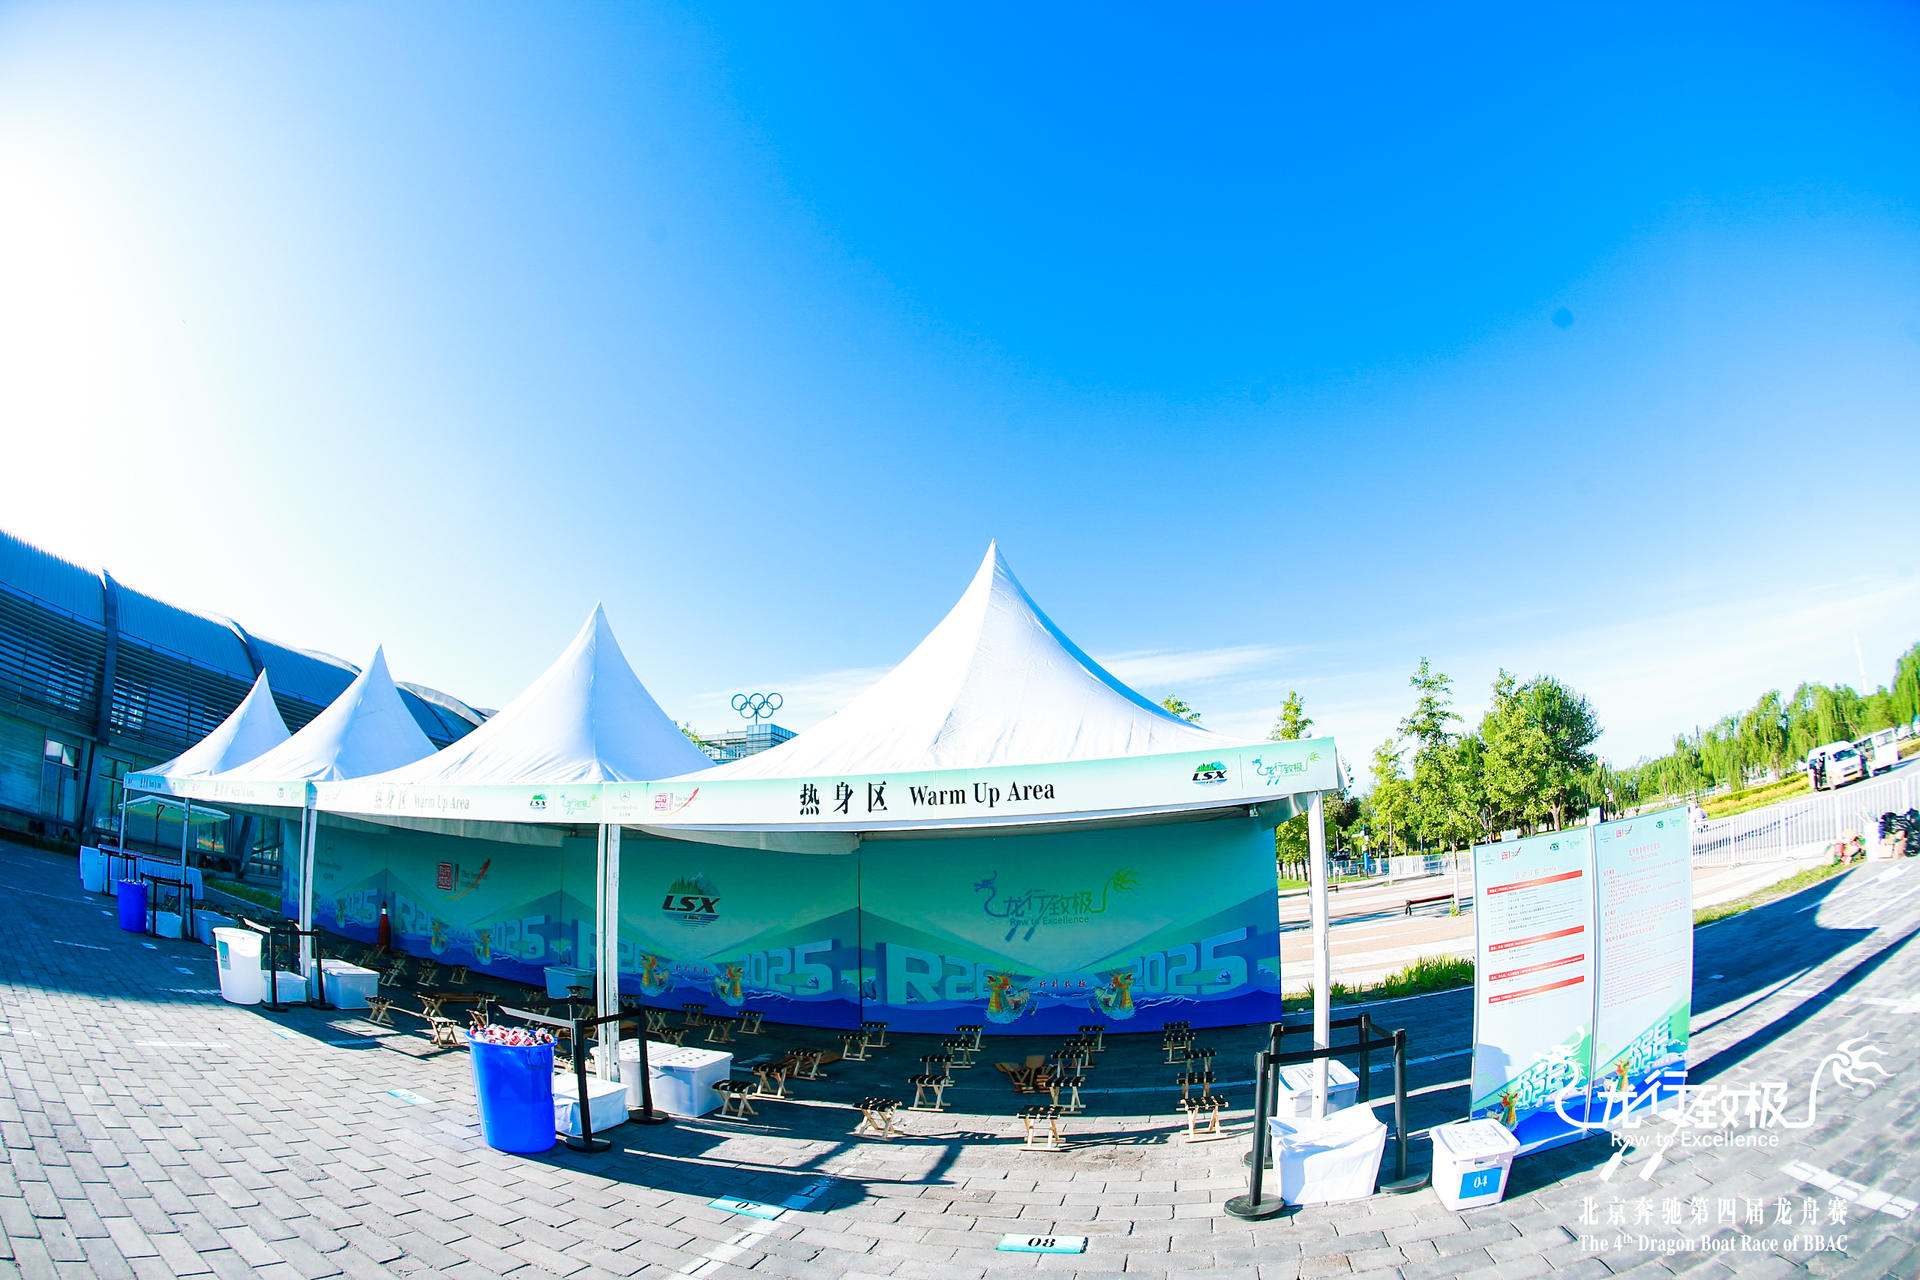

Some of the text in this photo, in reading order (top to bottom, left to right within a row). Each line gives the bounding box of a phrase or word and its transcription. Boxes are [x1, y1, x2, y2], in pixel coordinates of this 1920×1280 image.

[1192, 770, 1227, 782] LSX
[800, 781, 888, 815] 热身区
[909, 781, 1055, 808] Warm Up Area
[450, 795, 469, 809] Area
[662, 895, 720, 913] LSX
[1003, 889, 1092, 916] 龙行致极
[1043, 915, 1089, 926] Excellence
[1474, 1175, 1487, 1188] 04
[1028, 1237, 1056, 1248] 08
